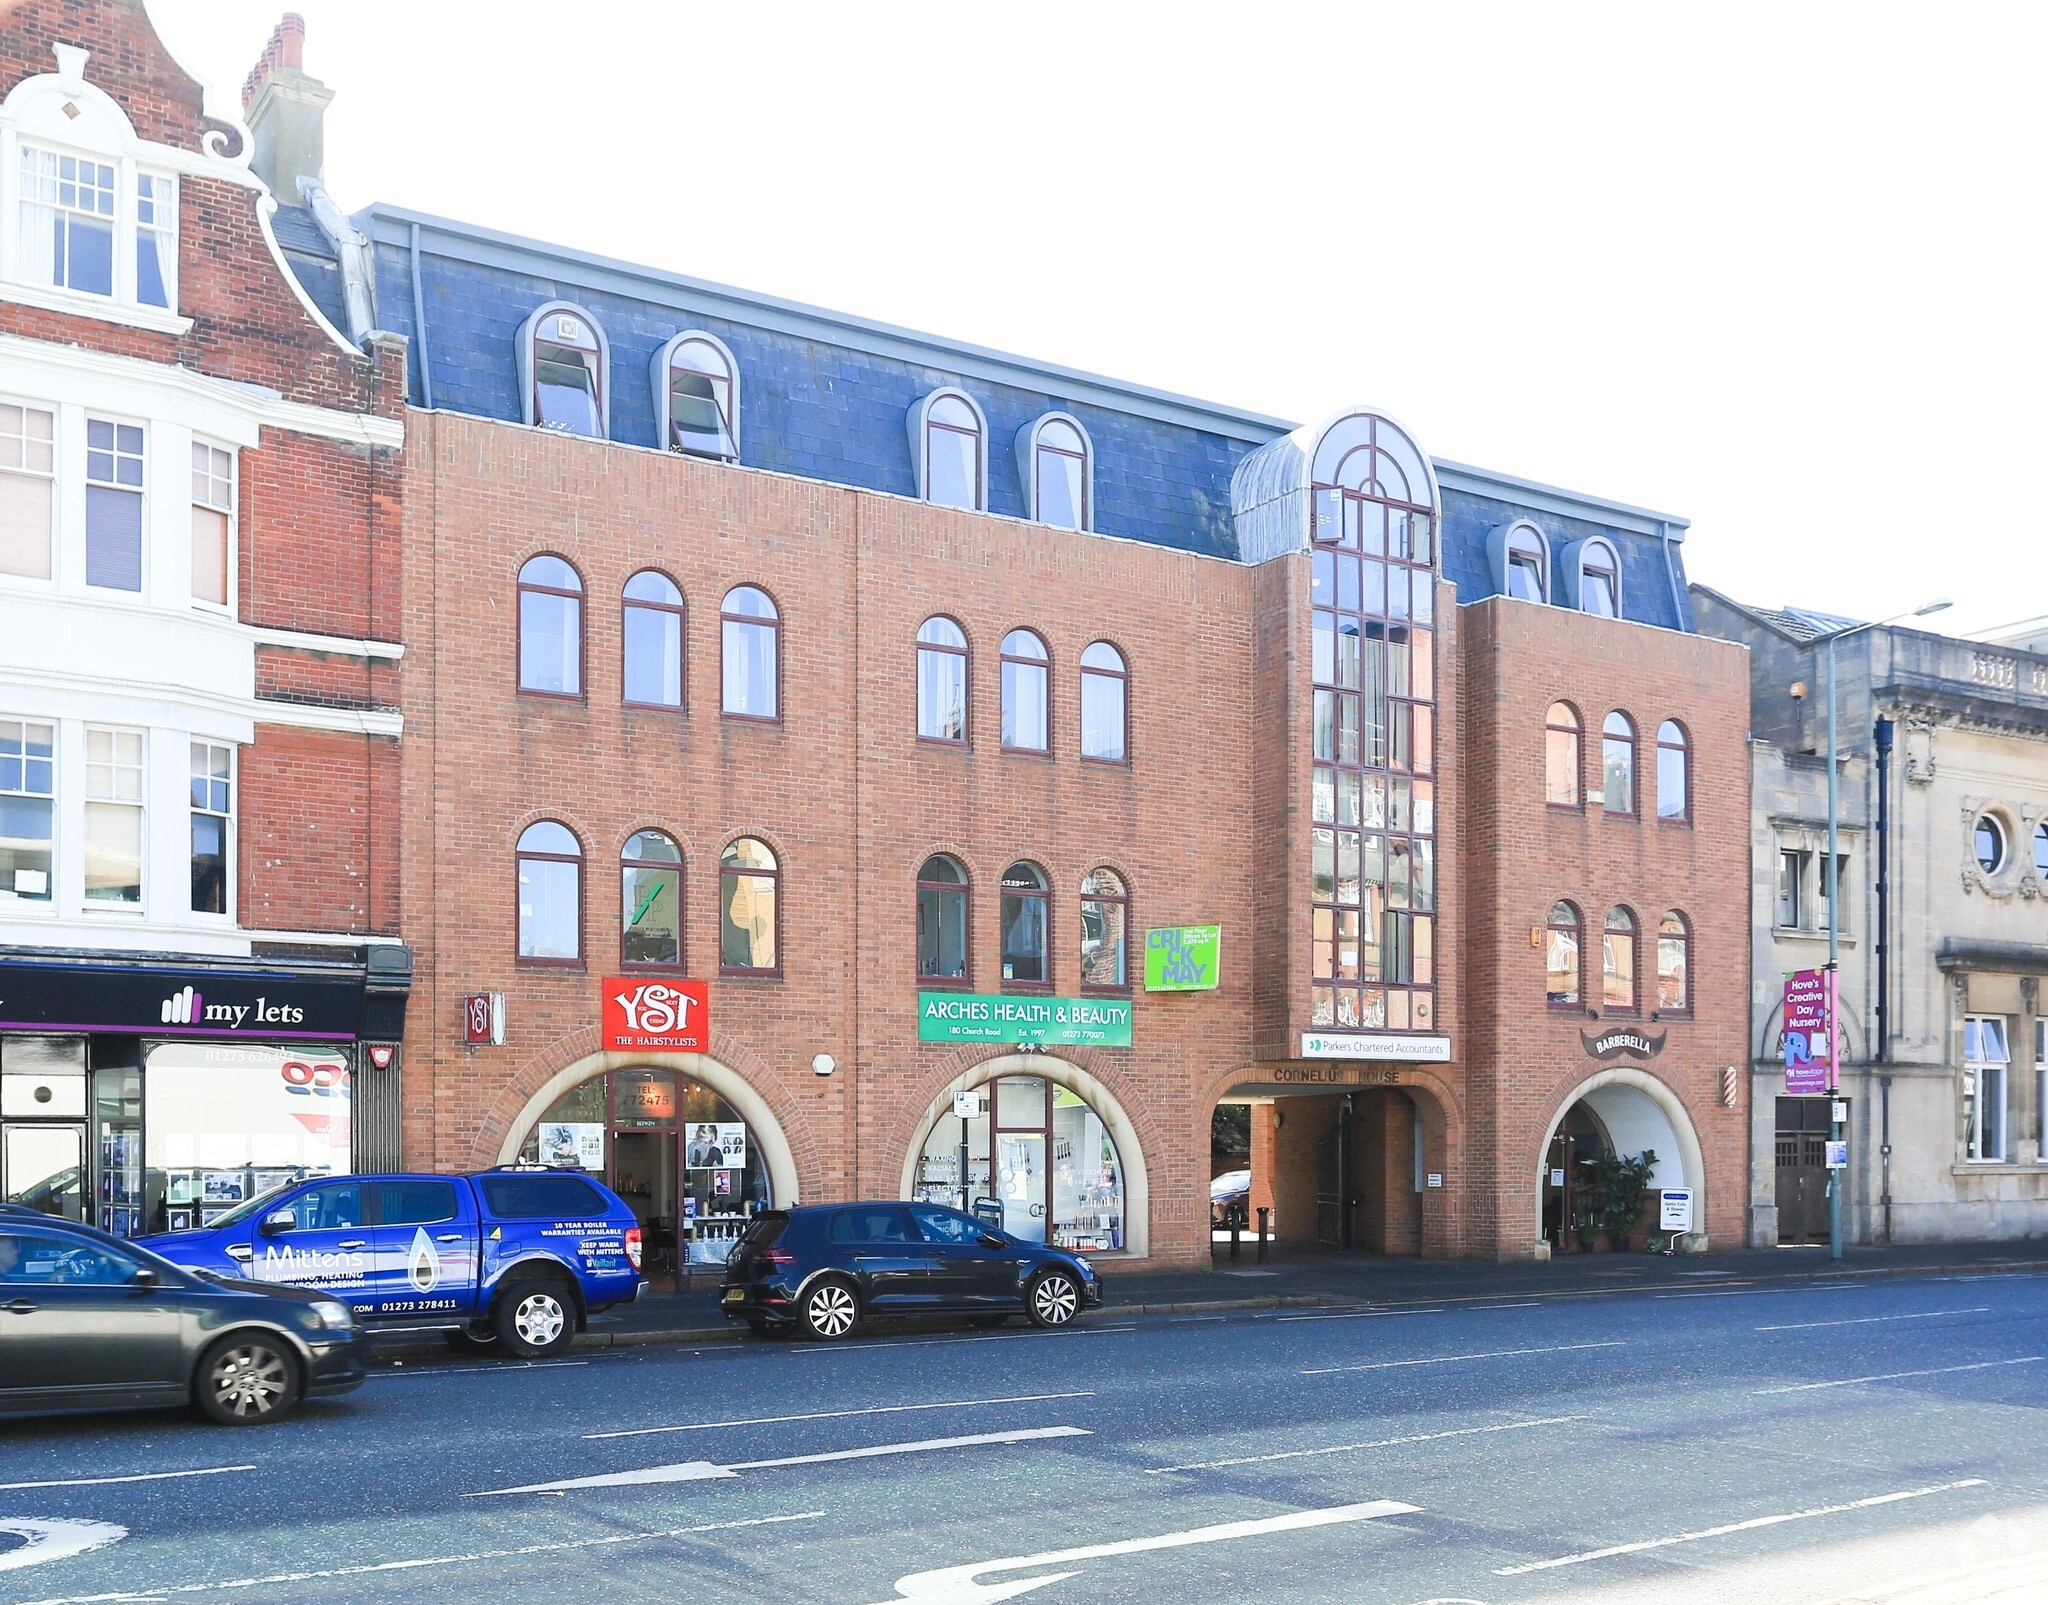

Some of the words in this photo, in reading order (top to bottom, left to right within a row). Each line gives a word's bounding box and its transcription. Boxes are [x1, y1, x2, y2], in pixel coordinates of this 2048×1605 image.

[1148, 929, 1181, 951] CRI
[1167, 946, 1196, 966] CK
[1162, 964, 1207, 984] MAY
[1791, 979, 1819, 990] Hove's
[1787, 992, 1823, 1003] Creative
[204, 1004, 250, 1029] my
[254, 997, 304, 1023] lets
[614, 984, 698, 1033] YST
[924, 1000, 989, 1020] ARCHES
[994, 1003, 1051, 1023] HEALTH
[1055, 1008, 1067, 1023] &
[1071, 1007, 1128, 1025] BEAUTY
[1797, 1005, 1814, 1015] Day
[469, 998, 490, 1033] YST
[1789, 1018, 1821, 1028] Nursery
[949, 1027, 960, 1035] 180
[962, 1027, 983, 1035] Church
[984, 1027, 1001, 1036] Road
[1018, 1029, 1028, 1037] Est.
[1030, 1029, 1045, 1037] 1997
[1062, 1030, 1080, 1038] 01273
[1082, 1031, 1105, 1039] 770072
[615, 1036, 633, 1045] THE
[637, 1036, 697, 1046] HAIRSTYLISTS
[1596, 1034, 1650, 1054] BARBERELLA
[1323, 1041, 1351, 1052] Parkers
[1353, 1041, 1394, 1053] Chartered
[1395, 1043, 1443, 1054] Accountants
[206, 1050, 245, 1062] 01273
[637, 1086, 655, 1094] TEL:
[946, 1174, 989, 1182] EXTSIONS
[265, 1245, 364, 1270] Mittens
[321, 1271, 364, 1280] HEATING
[330, 1280, 365, 1289] DESIGN
[382, 1301, 415, 1312] 01273
[418, 1299, 456, 1310] 278411
